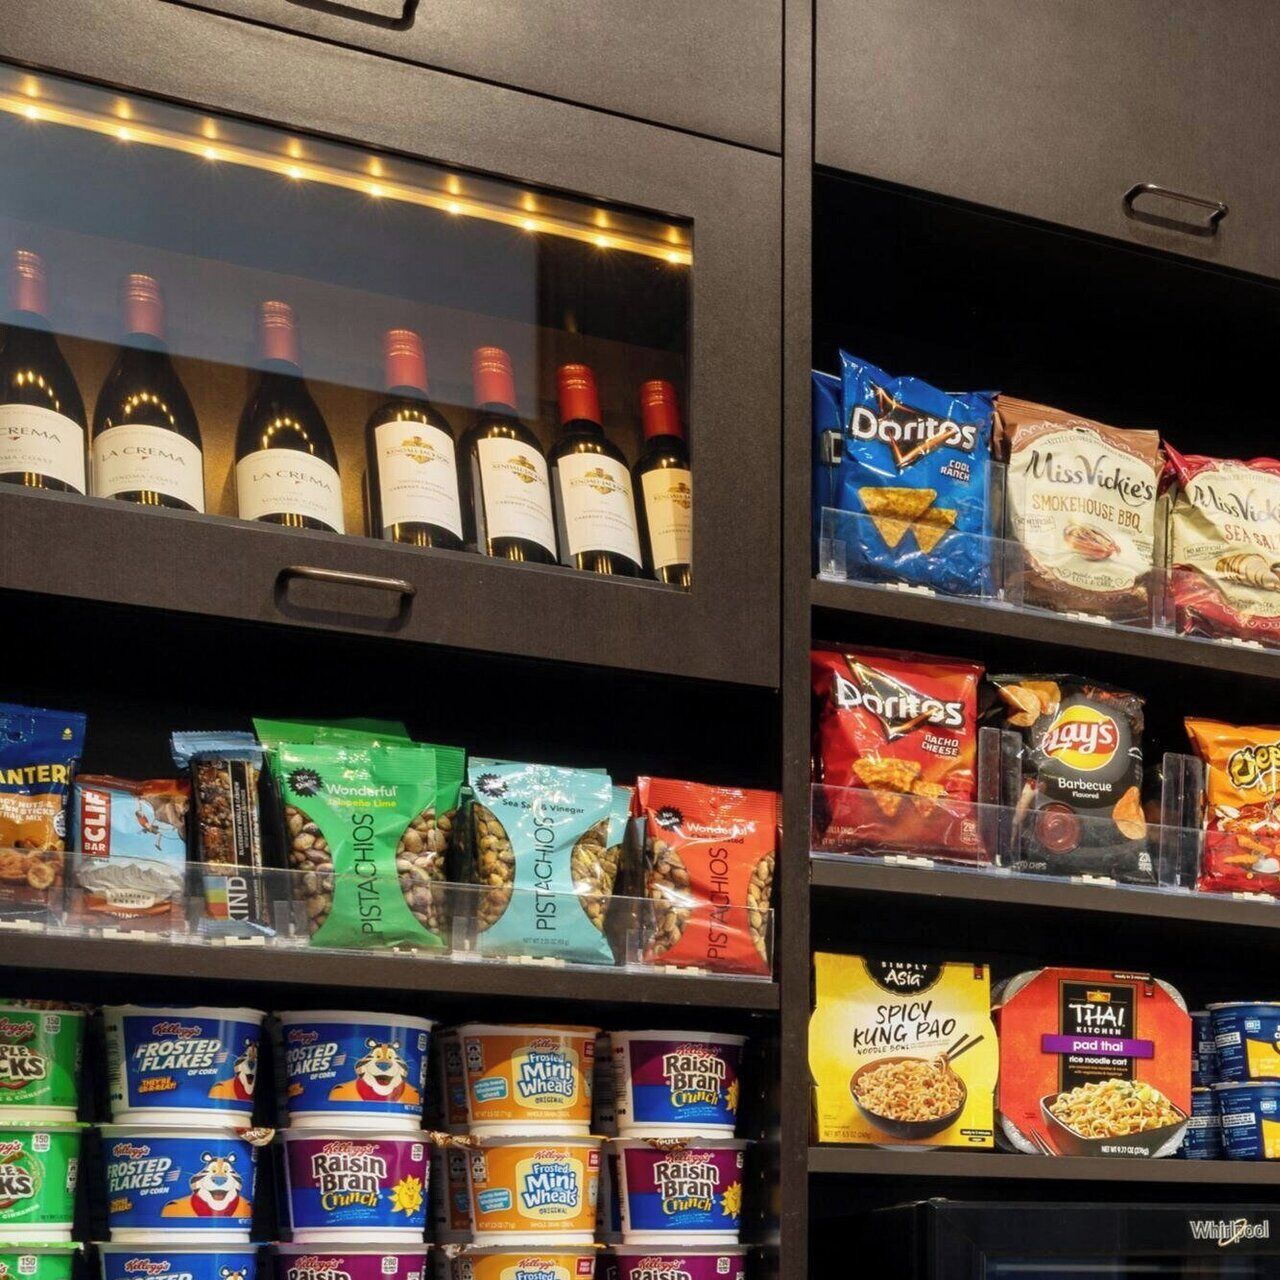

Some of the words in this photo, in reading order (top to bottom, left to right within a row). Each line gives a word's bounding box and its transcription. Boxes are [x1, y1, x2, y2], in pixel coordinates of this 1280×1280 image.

[852, 406, 977, 450] Doritos
[102, 448, 118, 462] LA
[123, 446, 186, 466] CREMA
[949, 460, 971, 472] COOL
[253, 470, 272, 483] LA
[277, 469, 333, 492] CREMA
[940, 467, 971, 481] RANCH
[1032, 494, 1116, 521] SMOKEHOUSE
[1117, 508, 1143, 533] BBQ
[1224, 524, 1251, 543] SEA
[834, 670, 964, 727] Doritos
[921, 742, 960, 757] CHEESE
[925, 734, 959, 748] NACHO
[326, 783, 399, 798] Wonderful
[1058, 777, 1113, 793] Barbecue
[1072, 790, 1100, 800] Flavored
[84, 791, 107, 842] CLIF
[84, 843, 106, 852] BAR
[352, 813, 383, 935] PISTACHIOS
[535, 817, 556, 931] PISTACHIOS
[707, 847, 730, 960] PISTACHIOS
[881, 961, 928, 971] SIMPLY
[885, 970, 921, 989] Asia
[876, 1000, 933, 1029] SPICY
[1068, 1003, 1125, 1028] THAI
[852, 1022, 908, 1047] KUNG
[916, 1018, 957, 1039] PAO
[1076, 1026, 1122, 1036] KITCHEN
[135, 1039, 222, 1061] FROSTED
[857, 1045, 888, 1056] NOODLE
[1072, 1039, 1099, 1053] pad
[1100, 1039, 1125, 1053] thai
[139, 1052, 214, 1073] FLAKES
[663, 1054, 725, 1076] Raisin
[1084, 1056, 1111, 1066] noodle
[521, 1062, 573, 1081] Mini
[670, 1071, 720, 1092] Bran
[518, 1077, 573, 1097] Wheats
[107, 1158, 172, 1179] FROSTED
[312, 1154, 386, 1180] Raisin
[533, 1163, 569, 1175] Frosted
[109, 1173, 164, 1191] FLAKES
[319, 1172, 380, 1195] Bran
[525, 1173, 576, 1192] Mini
[662, 1180, 713, 1200] Bran
[321, 1191, 379, 1211] Crunch
[522, 1188, 577, 1208] Wheats
[662, 1197, 713, 1214] Crunch
[1189, 1218, 1269, 1246] Whirlpool
